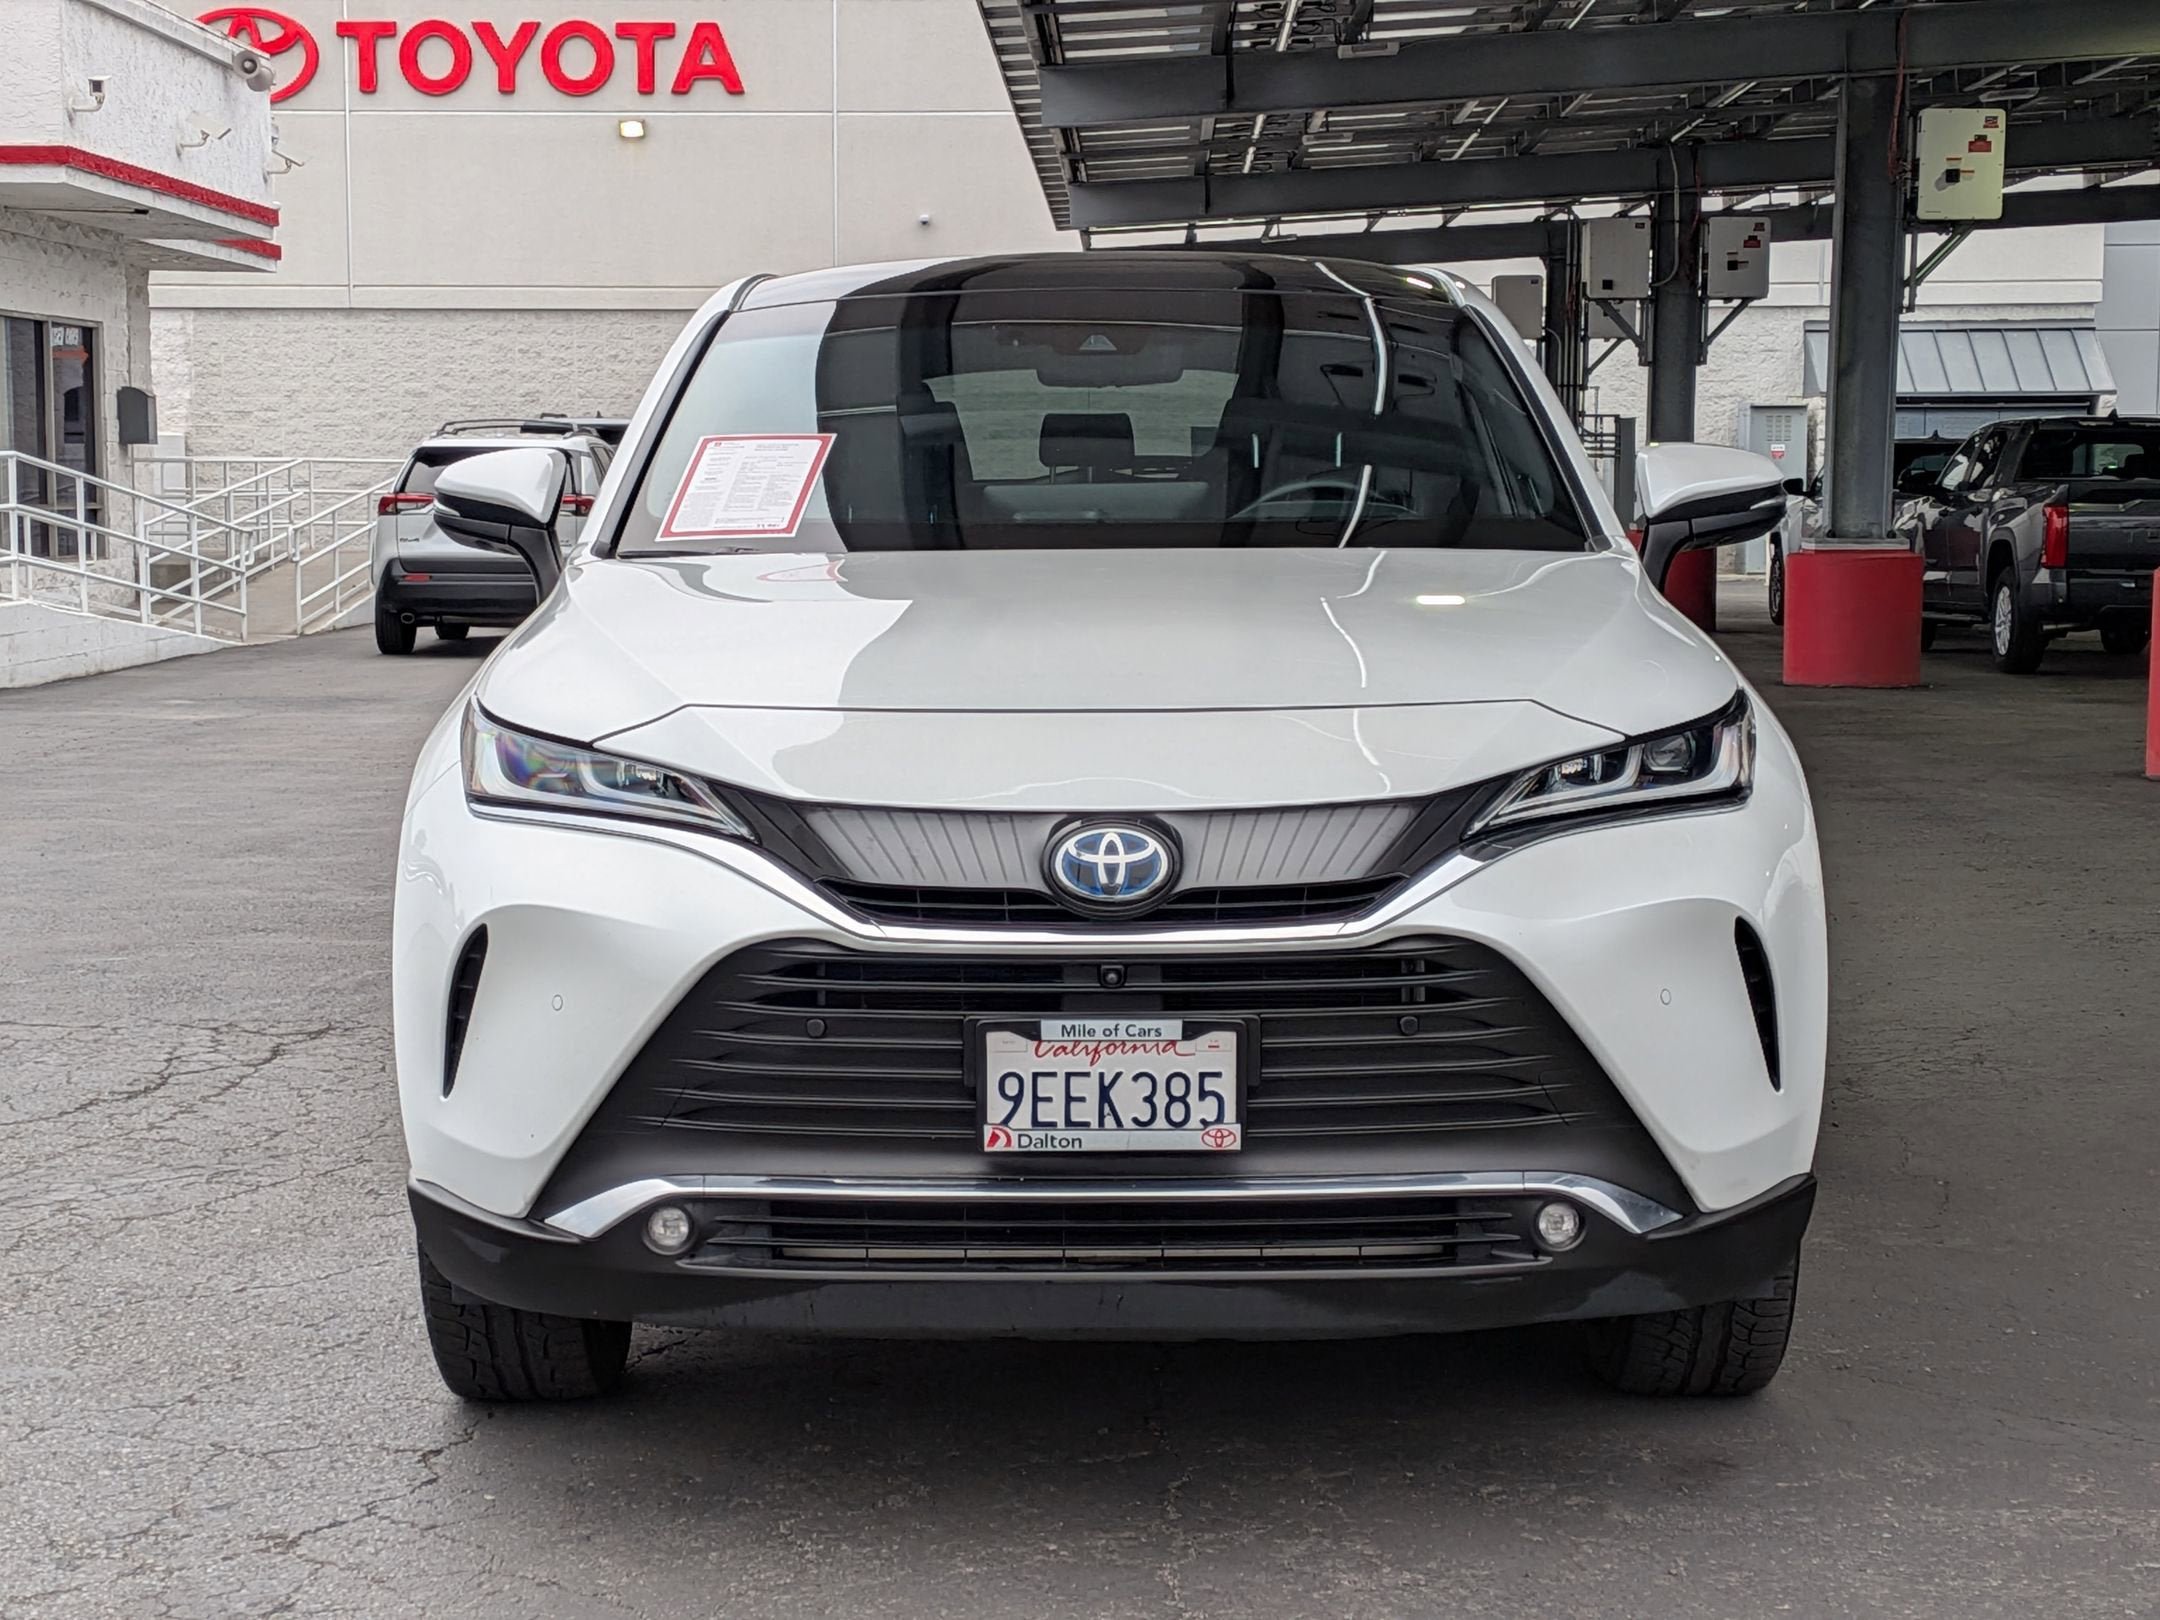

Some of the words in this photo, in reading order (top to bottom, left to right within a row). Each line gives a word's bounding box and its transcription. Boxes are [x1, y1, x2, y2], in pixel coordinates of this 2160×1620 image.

[336, 19, 745, 96] TOYOTA
[1061, 1024, 1097, 1037] Mile
[1102, 1023, 1120, 1037] of
[1125, 1024, 1162, 1037] Cars
[1034, 1040, 1196, 1067] California
[998, 1071, 1226, 1128] 9EEK385
[1017, 1133, 1083, 1149] Dalton
